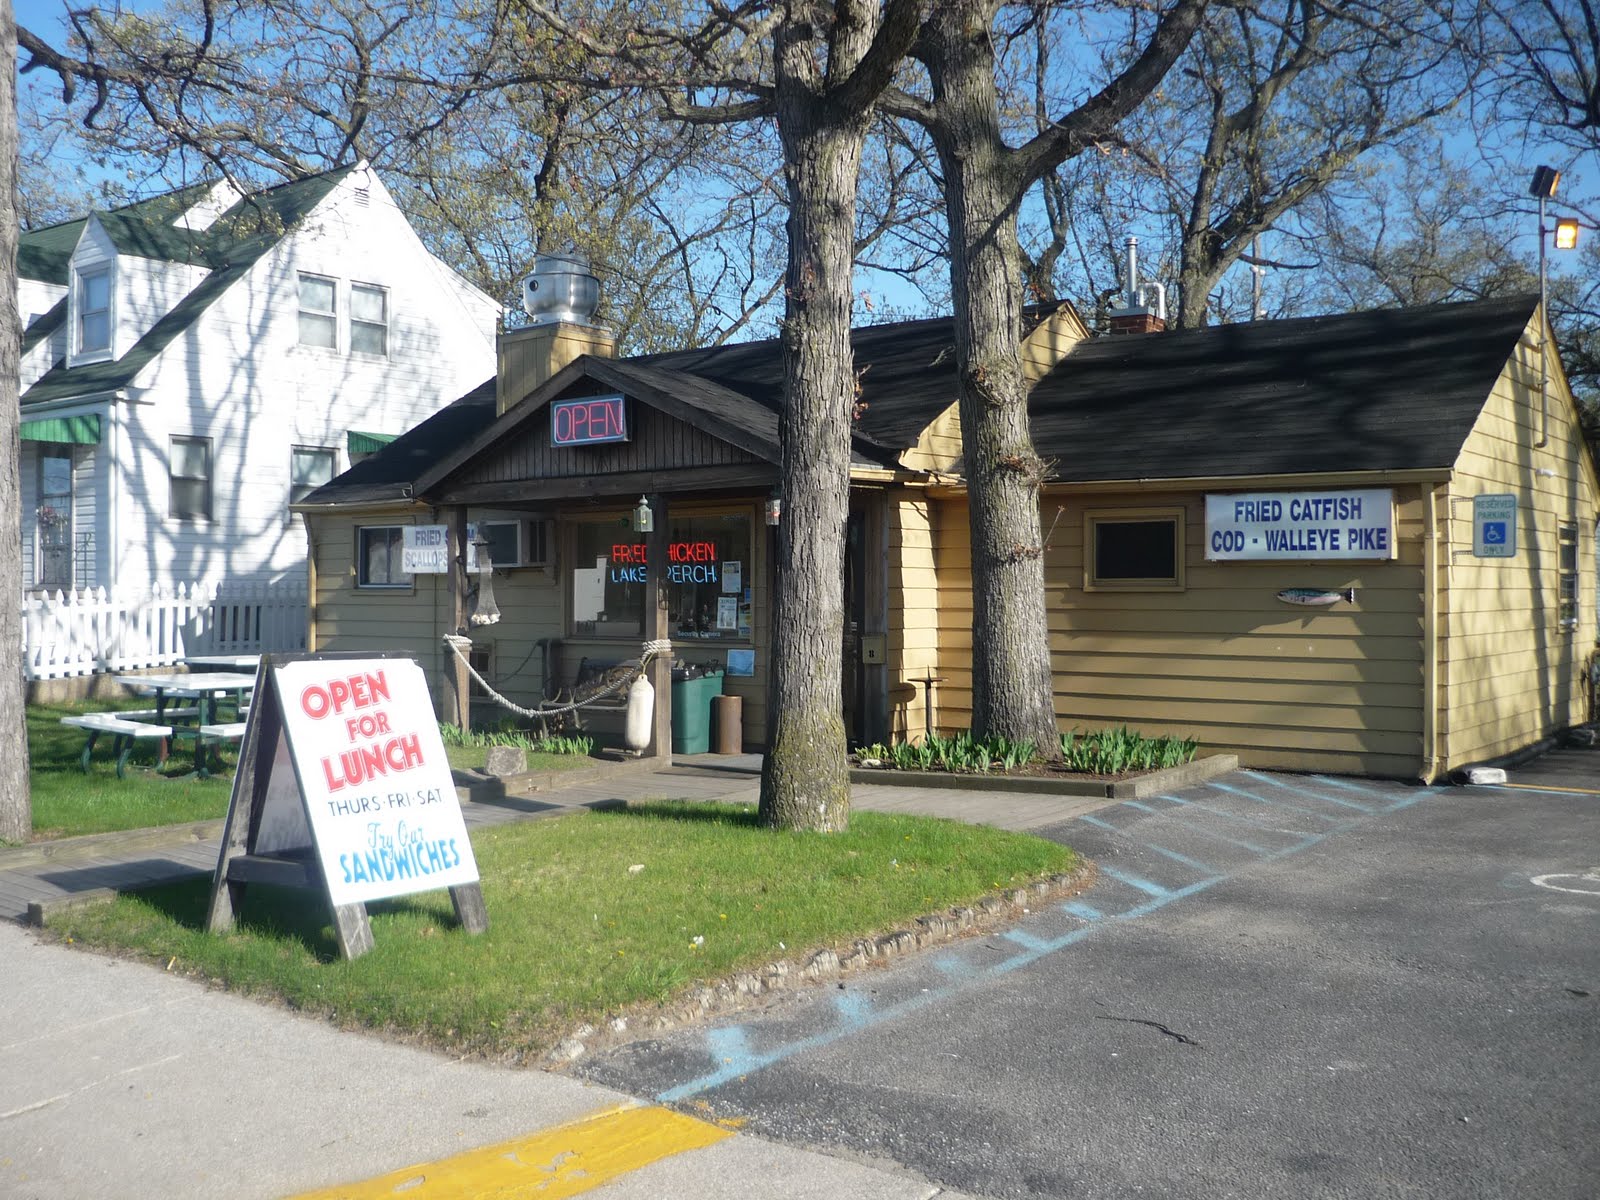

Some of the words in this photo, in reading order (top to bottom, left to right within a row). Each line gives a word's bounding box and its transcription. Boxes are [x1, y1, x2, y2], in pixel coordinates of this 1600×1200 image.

[556, 402, 622, 440] OPEN
[1234, 499, 1282, 523] FRIED
[1290, 497, 1362, 522] CATFISH
[1476, 500, 1514, 509] RESERVED
[1477, 511, 1511, 520] PARKING
[415, 529, 441, 546] FRIED
[1211, 530, 1245, 552] COD
[1265, 528, 1340, 552] WALLEYE
[1347, 527, 1387, 551] PIKE
[1483, 546, 1505, 554] ONLY
[611, 566, 647, 583] LAKE
[300, 669, 393, 721] OPEN
[345, 710, 392, 743] FOR
[320, 732, 425, 793] LUNCH
[328, 795, 381, 816] THURS
[387, 792, 411, 808] FRI
[417, 788, 442, 805] SAT
[367, 822, 394, 860] Try
[398, 820, 424, 847] Our
[339, 838, 460, 883] SANDWICHES
